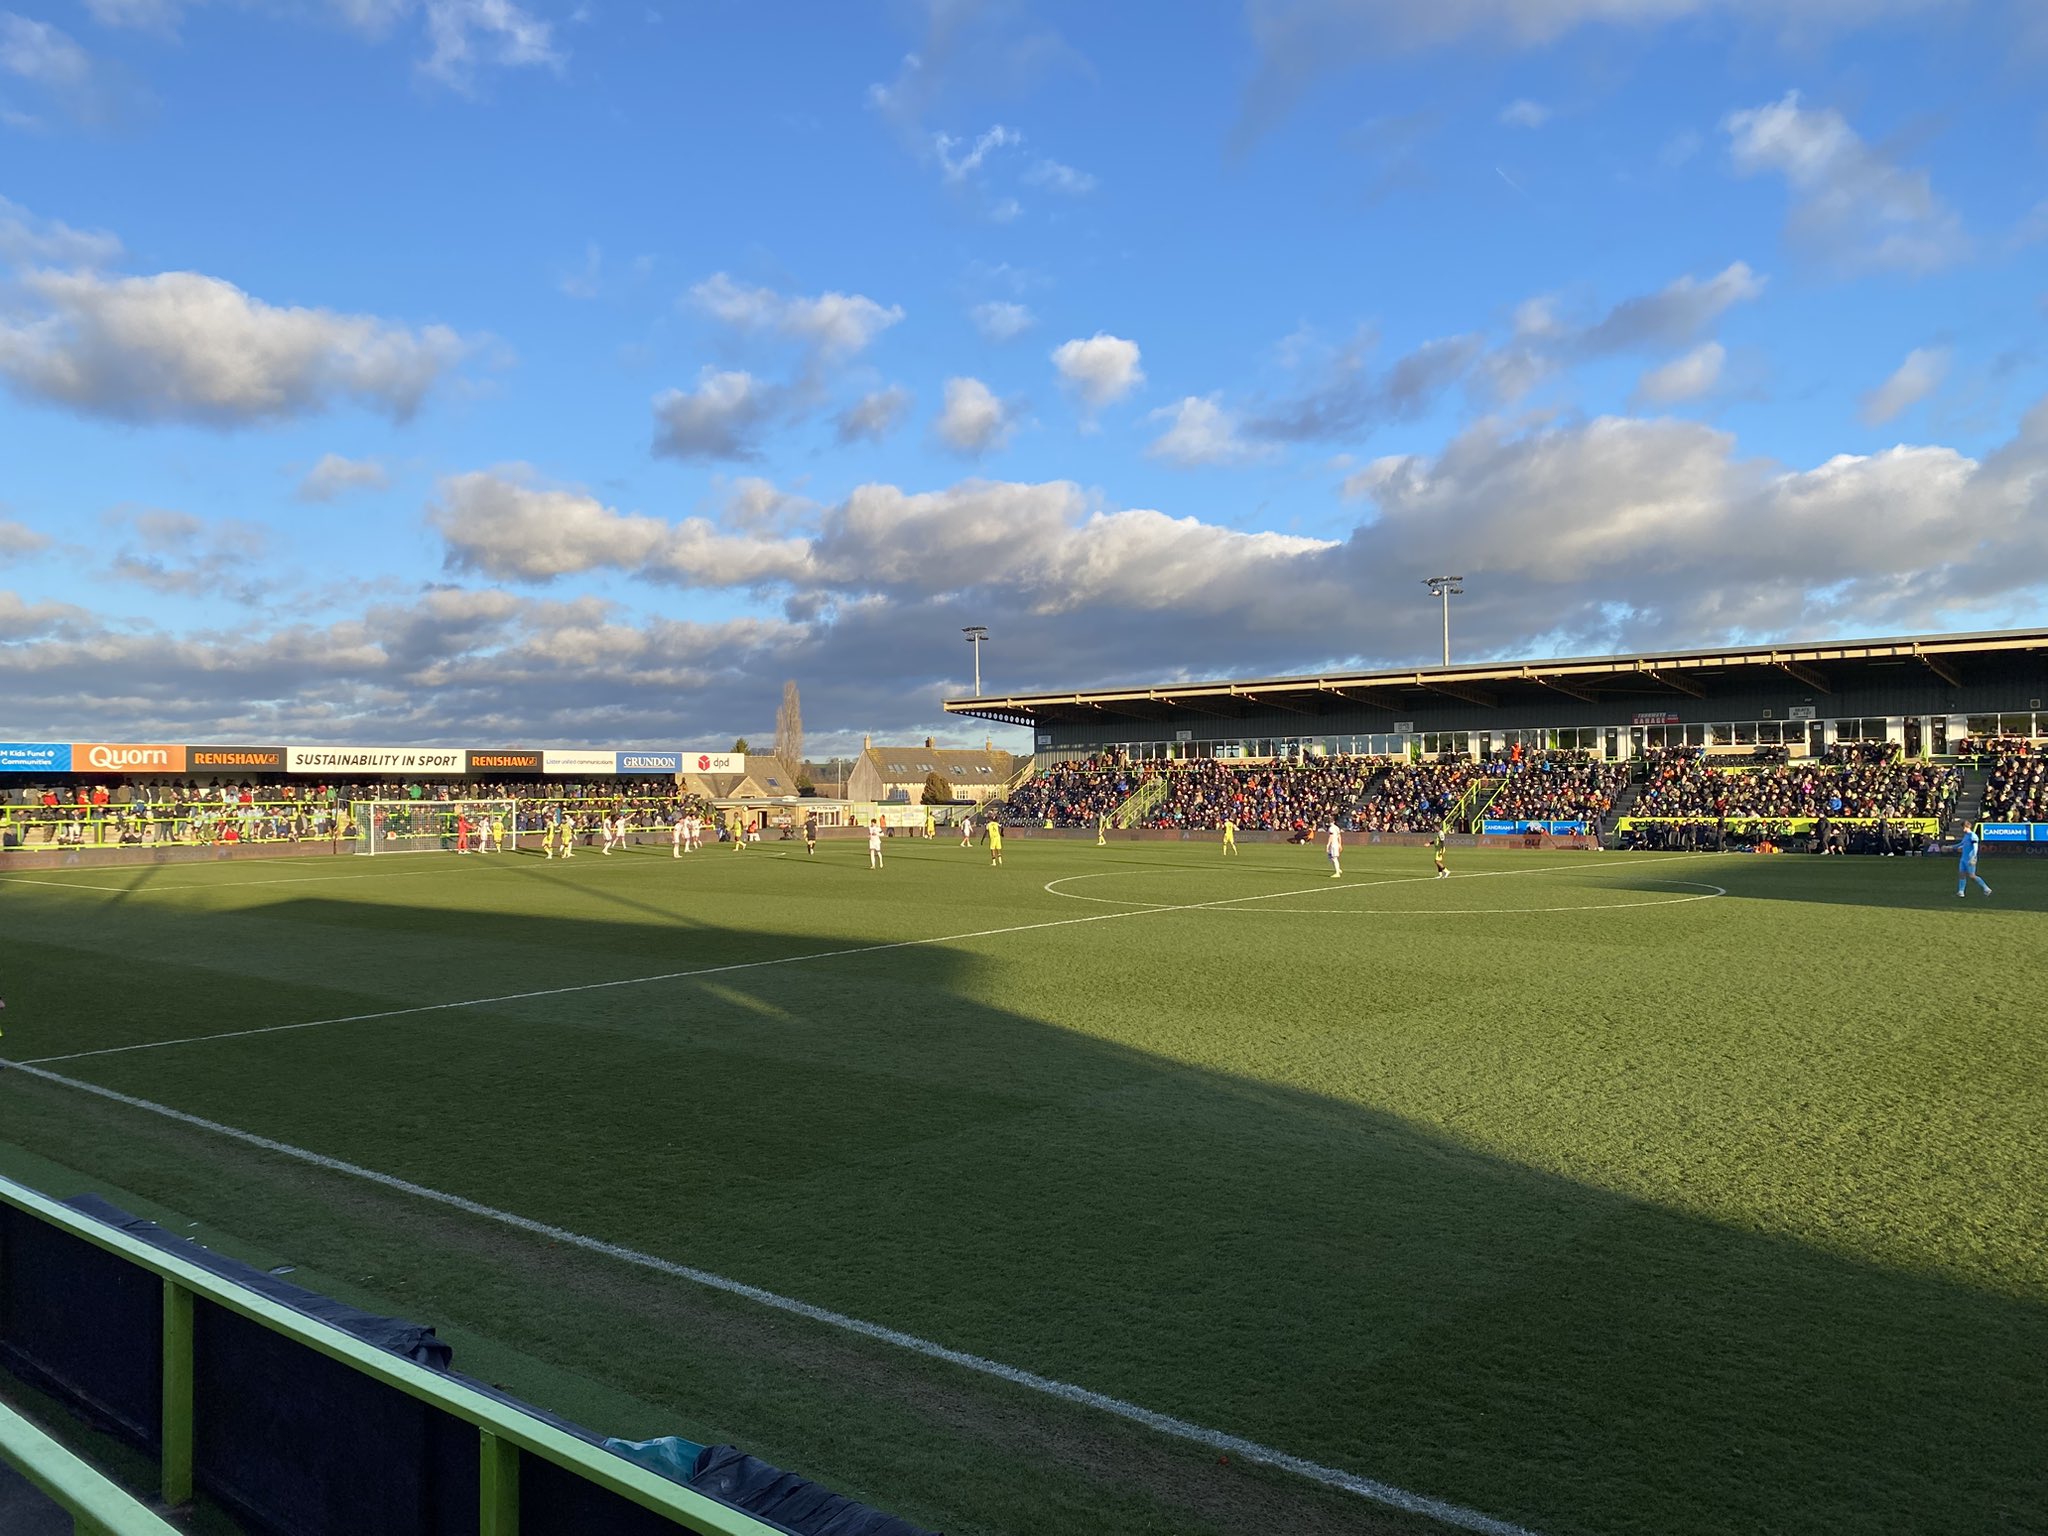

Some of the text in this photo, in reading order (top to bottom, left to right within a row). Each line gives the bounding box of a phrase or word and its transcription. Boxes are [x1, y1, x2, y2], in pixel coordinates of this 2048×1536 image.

[1, 758, 52, 766] Communities
[89, 746, 167, 769] Quorn
[194, 752, 269, 765] RENISHAW
[296, 754, 457, 767] SUSTAINABILITY IN SPORT
[472, 756, 529, 767] RENISHAW
[623, 757, 676, 768] GRUNDON
[713, 758, 730, 769] dpd
